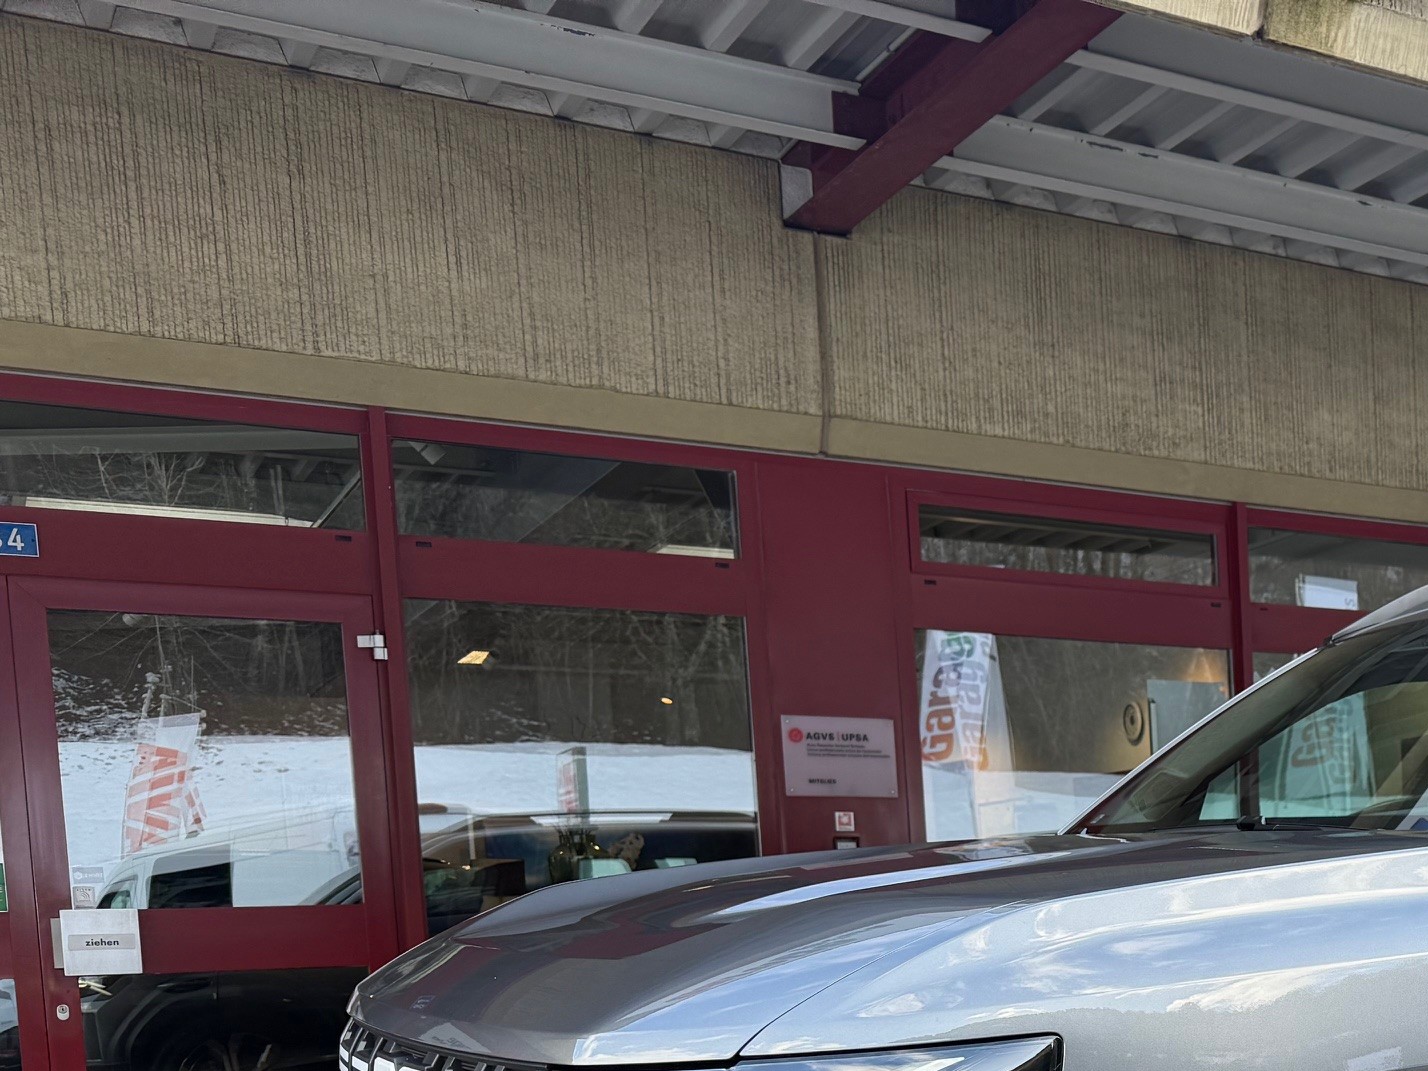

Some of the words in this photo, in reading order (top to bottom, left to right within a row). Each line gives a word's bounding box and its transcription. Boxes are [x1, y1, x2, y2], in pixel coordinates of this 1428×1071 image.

[0, 527, 25, 551] 4
[806, 732, 835, 741] AGVS
[841, 733, 869, 742] UPSA
[85, 938, 120, 947] ziehen
